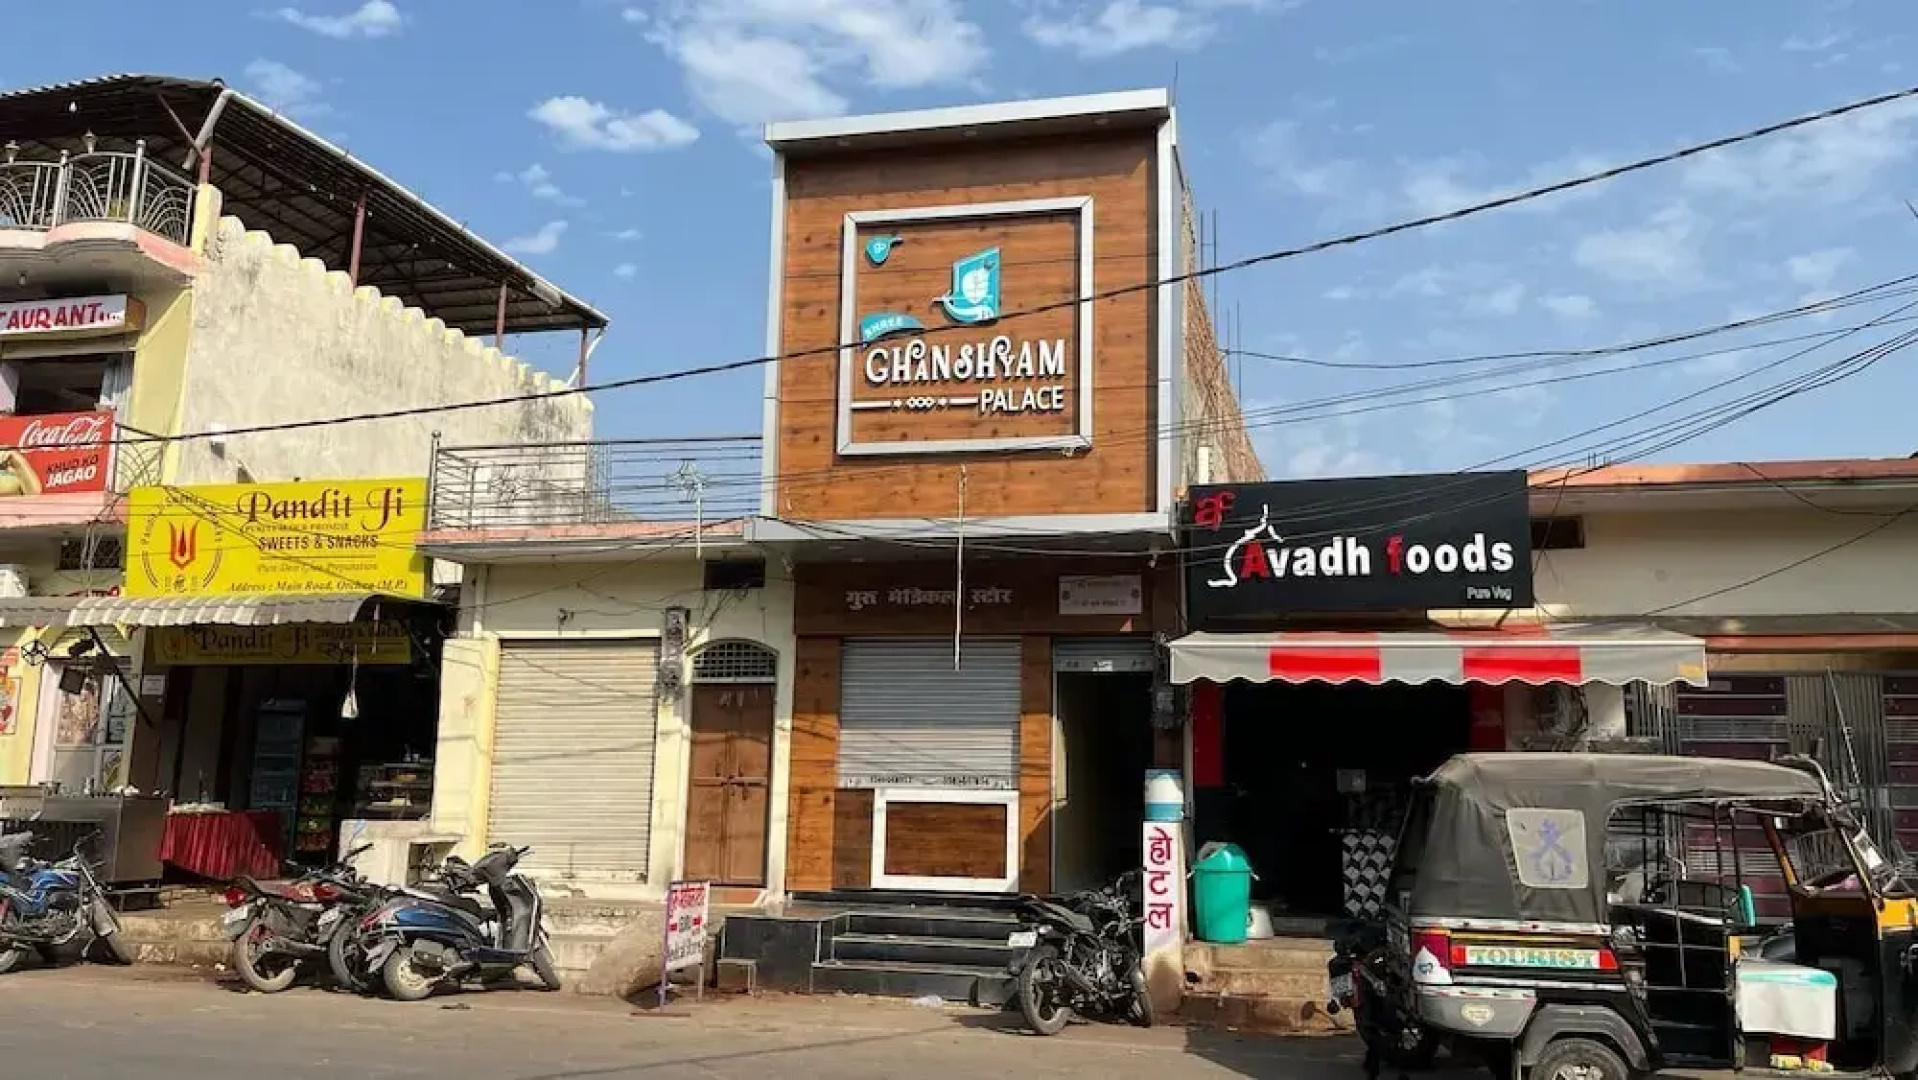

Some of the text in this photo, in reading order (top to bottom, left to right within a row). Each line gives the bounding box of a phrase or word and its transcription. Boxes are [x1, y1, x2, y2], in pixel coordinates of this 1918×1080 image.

[866, 336, 1066, 383] GHANSHYAM
[981, 385, 1065, 412] PALACE
[46, 465, 97, 488] JAGAO
[237, 489, 353, 522] Pandit
[361, 487, 403, 531] Ji
[258, 535, 379, 550] SWEETS & SNACKS
[1242, 533, 1514, 578] Avadh foods
[1491, 585, 1512, 601] Veg
[1470, 949, 1594, 965] TOURIST
